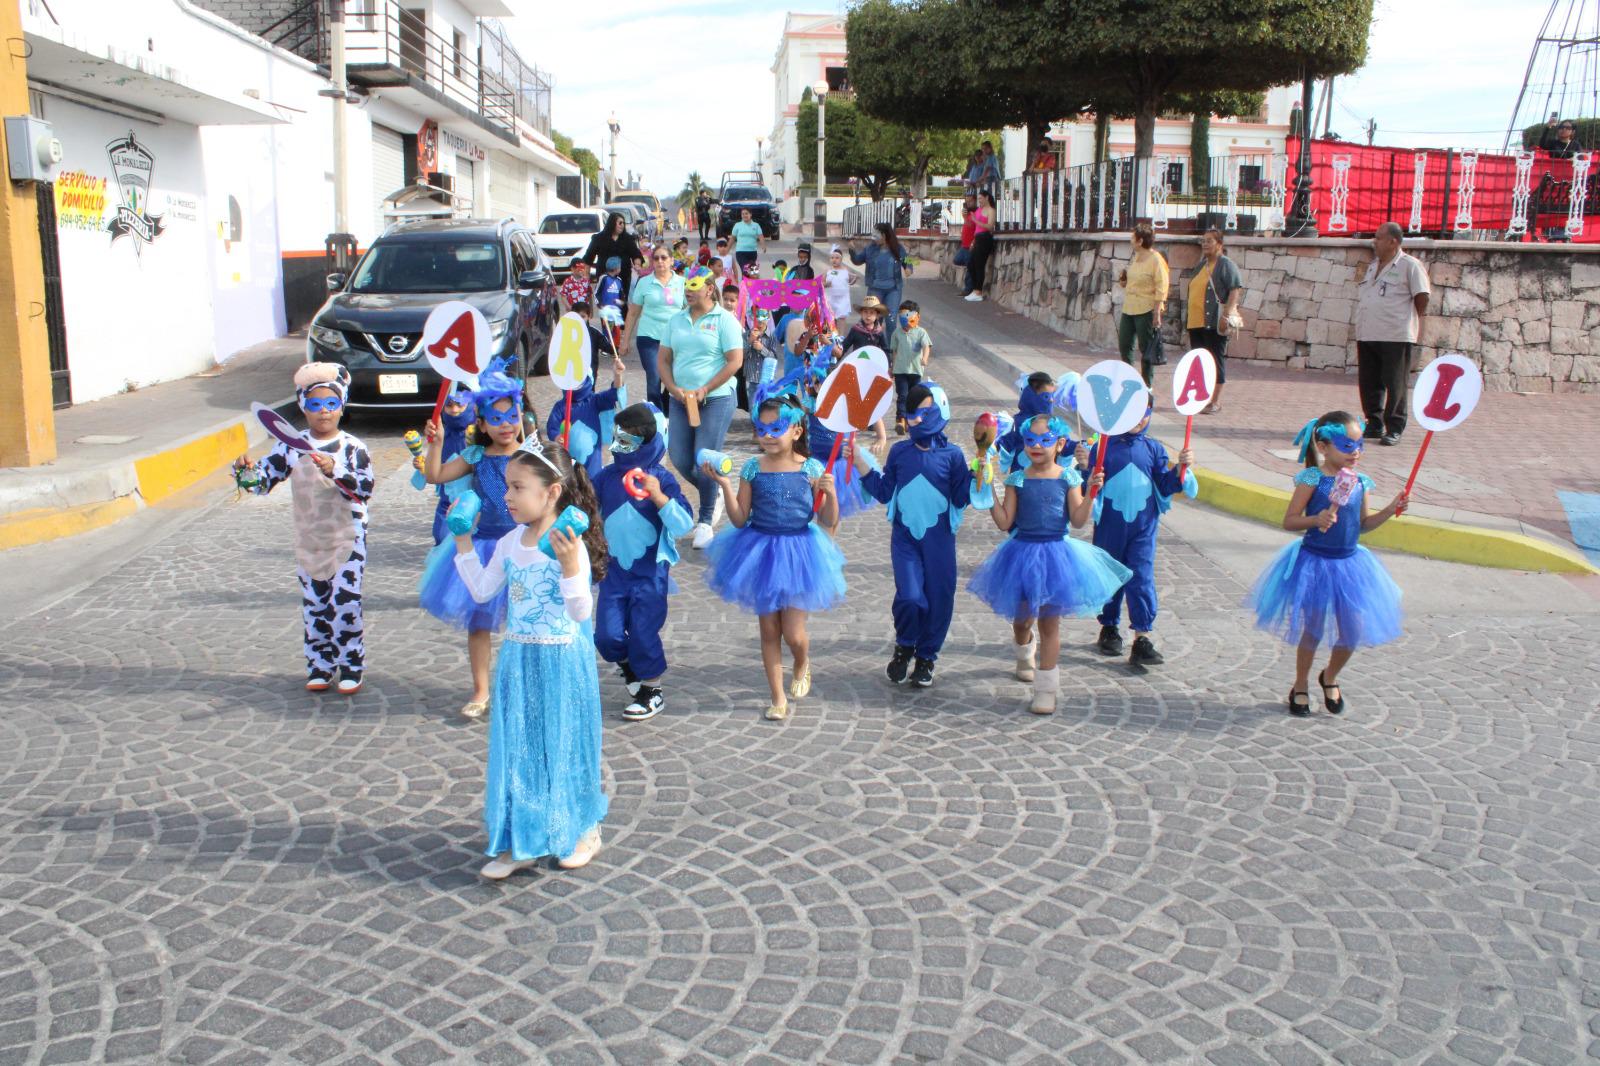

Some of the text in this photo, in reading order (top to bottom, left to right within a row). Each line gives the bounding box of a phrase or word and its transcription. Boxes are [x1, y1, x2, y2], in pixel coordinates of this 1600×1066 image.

[59, 170, 107, 191] SERVICIO A
[62, 191, 104, 211] DOMICILIO
[120, 208, 150, 239] PIZZERIA
[428, 310, 479, 374] A
[552, 316, 584, 382] R
[813, 362, 893, 432] N
[1086, 374, 1142, 432] V
[1176, 355, 1210, 406] A
[1423, 363, 1465, 422] L
